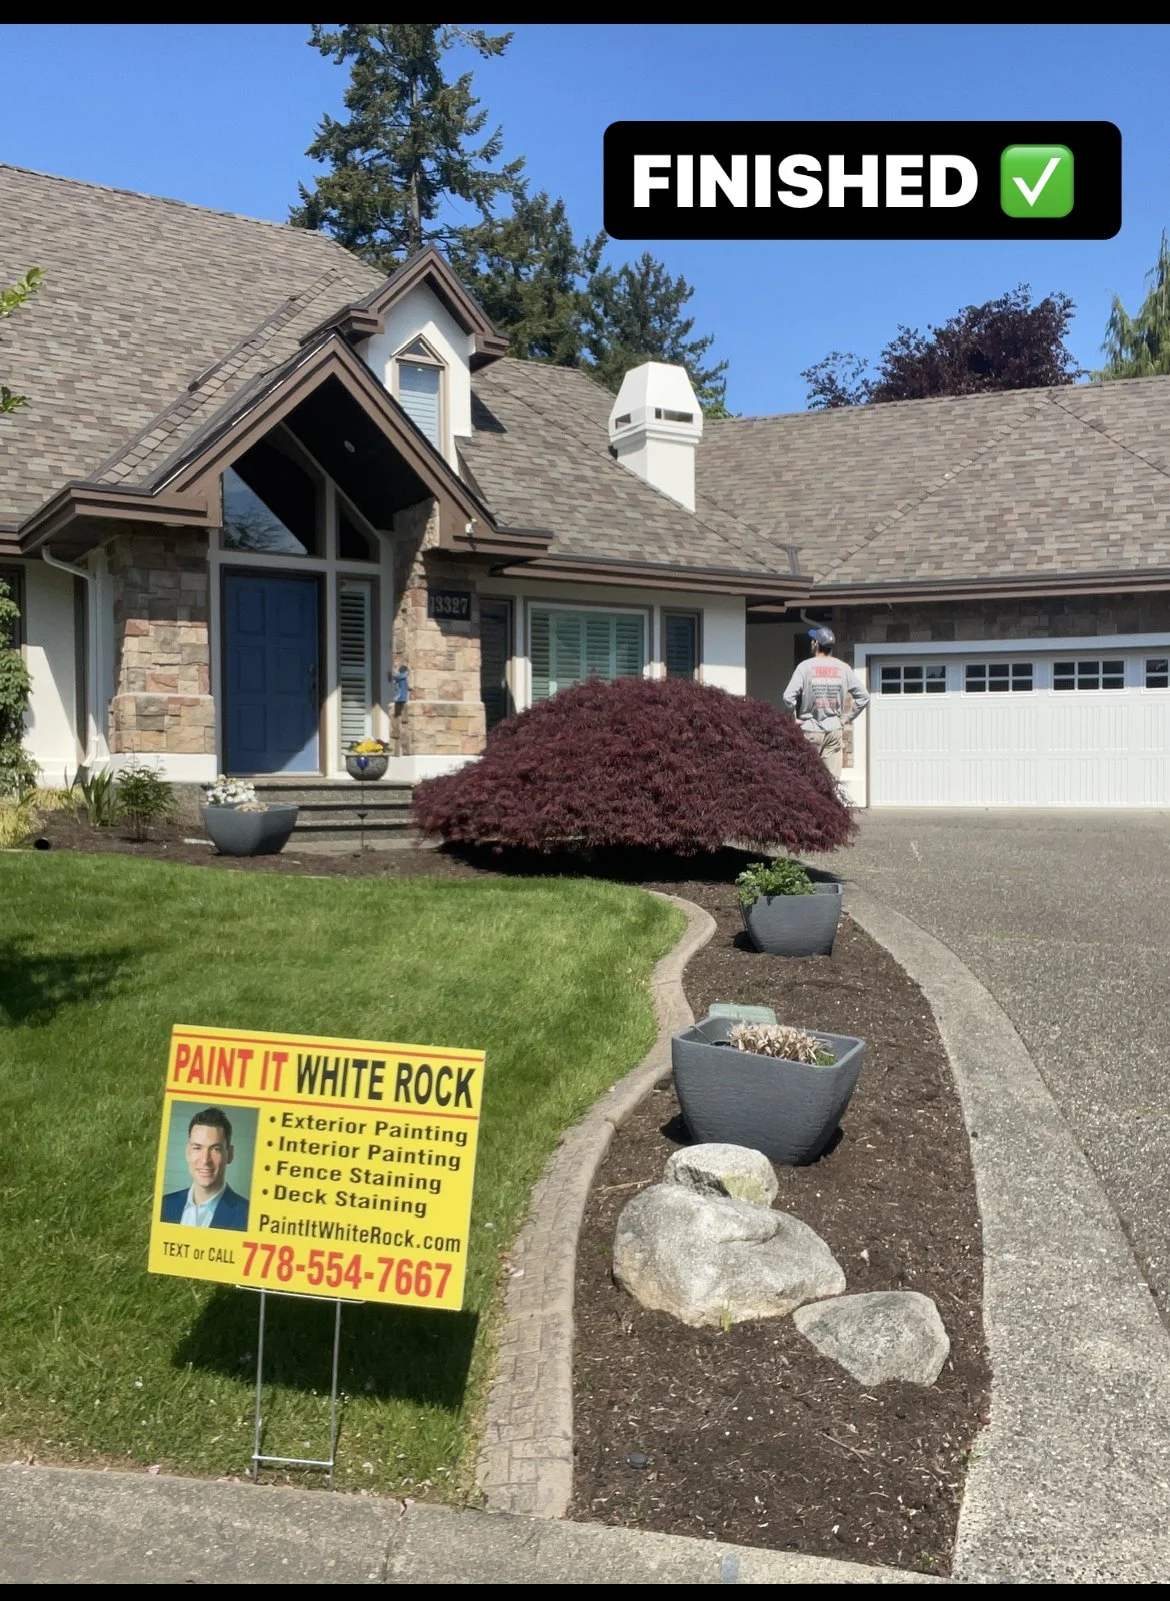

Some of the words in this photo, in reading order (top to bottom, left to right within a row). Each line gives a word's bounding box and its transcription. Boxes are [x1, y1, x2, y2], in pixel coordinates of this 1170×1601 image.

[173, 1043, 254, 1089] PAINT
[260, 1051, 289, 1092] IT
[296, 1053, 387, 1101] WHITE
[394, 1062, 477, 1109] ROCK
[281, 1112, 366, 1136] Exterior
[374, 1121, 468, 1147] Painting
[279, 1136, 360, 1160] Interior
[367, 1145, 461, 1171] Painting
[276, 1160, 342, 1182] Fence
[350, 1167, 442, 1195] Staining
[274, 1185, 326, 1205] Deck
[335, 1191, 427, 1218] Staining
[259, 1214, 461, 1253] PaintItWhiteRock.com
[163, 1242, 190, 1259] TEXT
[193, 1248, 206, 1261] or
[208, 1246, 235, 1264] CALL
[241, 1241, 453, 1299] 778-554-7667
